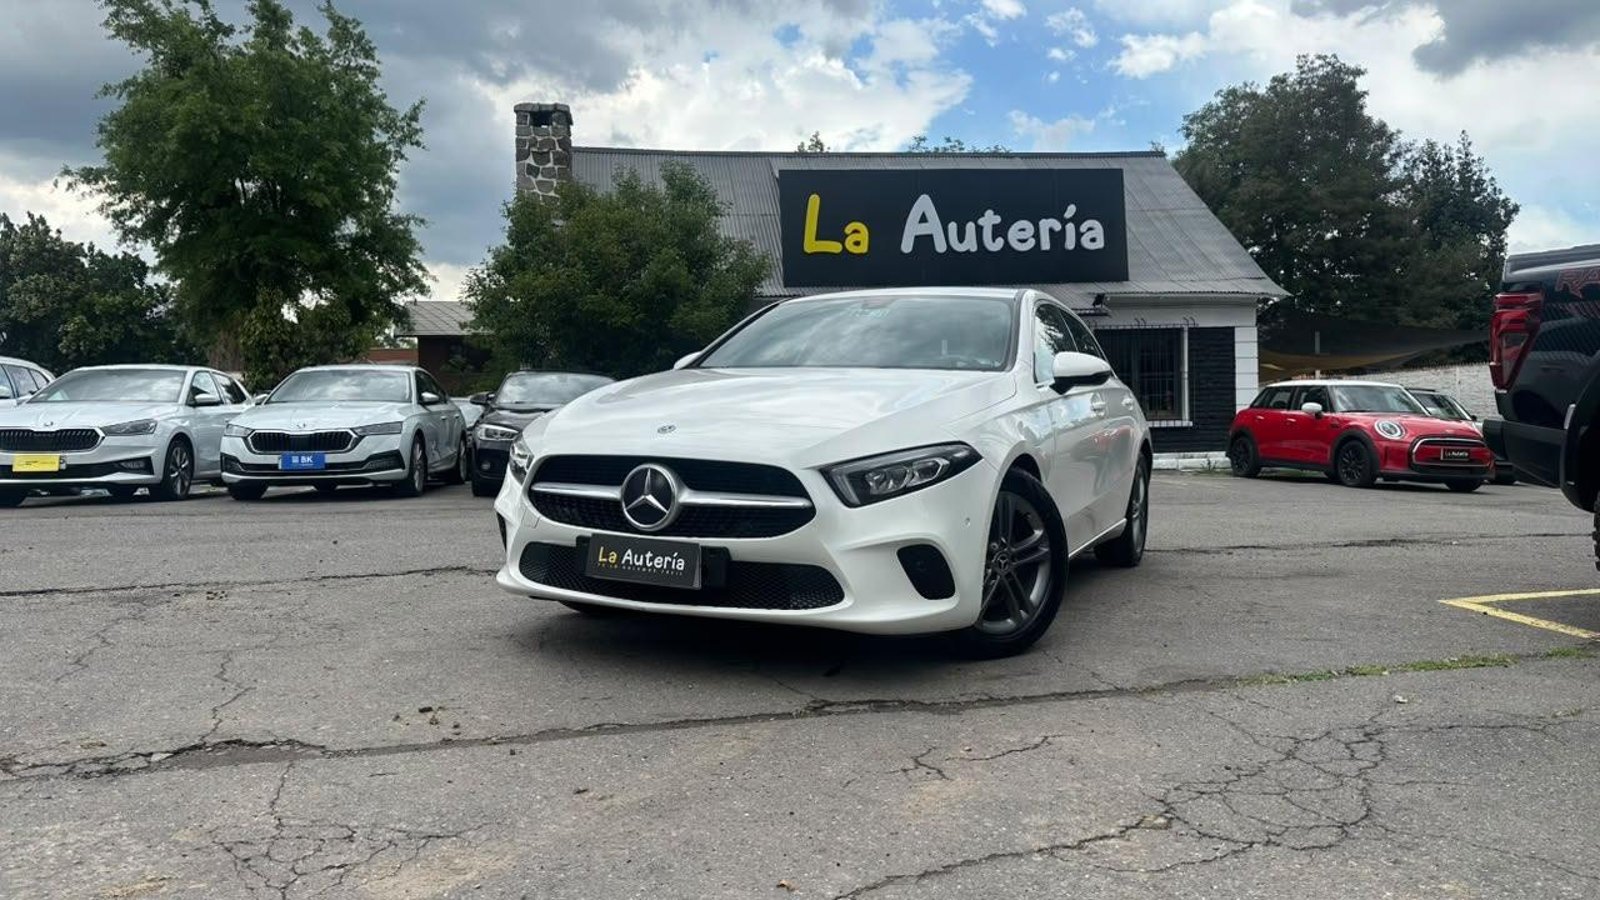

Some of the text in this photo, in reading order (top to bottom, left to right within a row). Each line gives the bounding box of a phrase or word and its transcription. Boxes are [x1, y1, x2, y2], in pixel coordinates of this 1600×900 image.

[803, 193, 1105, 253] La Autería
[598, 546, 618, 564] La
[621, 548, 685, 571] Autería
